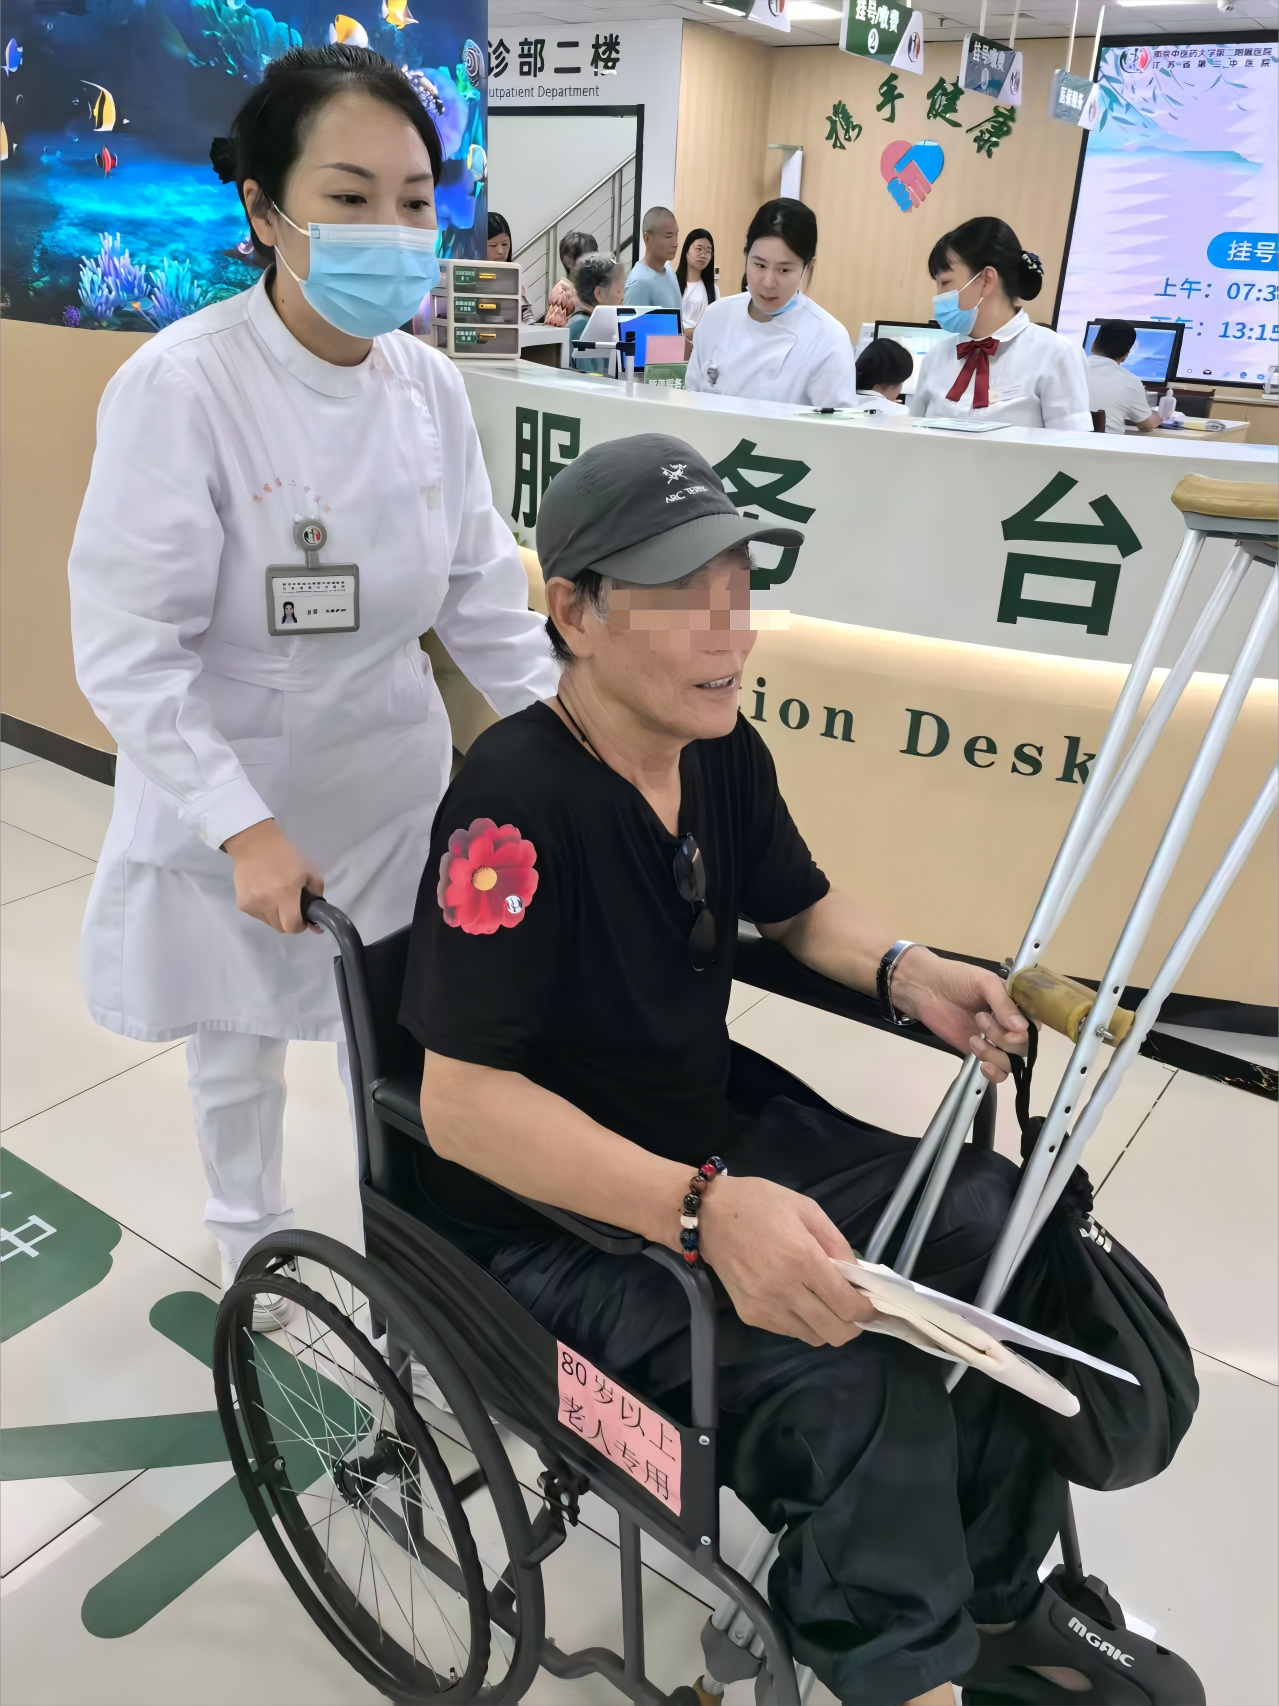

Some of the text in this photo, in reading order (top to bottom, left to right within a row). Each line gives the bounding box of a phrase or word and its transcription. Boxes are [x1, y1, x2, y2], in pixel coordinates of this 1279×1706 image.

[488, 33, 620, 78] 诊部二楼
[488, 85, 600, 100] utpatient Department
[1226, 240, 1279, 263] 挂号
[1226, 283, 1279, 302] 07:3
[899, 707, 1097, 785] Desk
[559, 1394, 669, 1500] 老人专用
